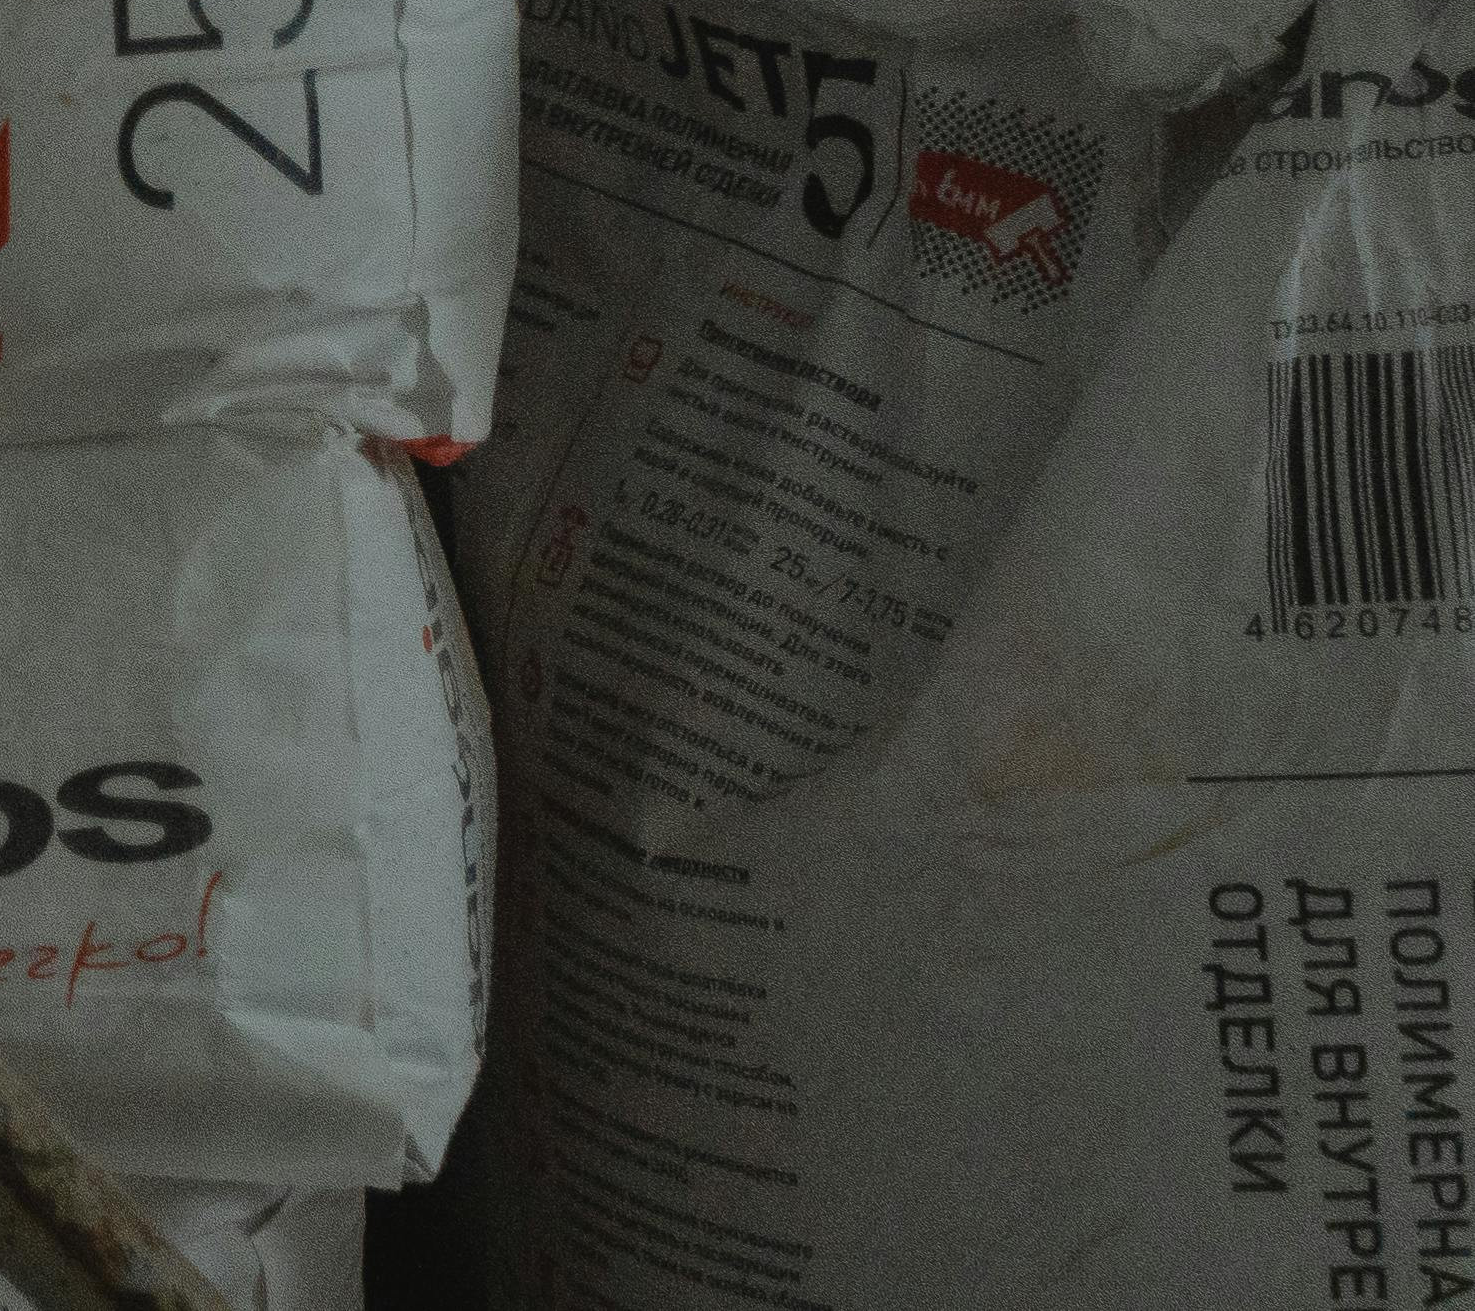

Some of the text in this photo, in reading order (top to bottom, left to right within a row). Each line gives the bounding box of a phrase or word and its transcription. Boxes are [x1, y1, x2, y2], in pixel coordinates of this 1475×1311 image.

[801, 54, 876, 240] 5
[1203, 882, 1287, 1194] ОТДЕЛКИ
[1284, 878, 1361, 1016] ДЛЯ
